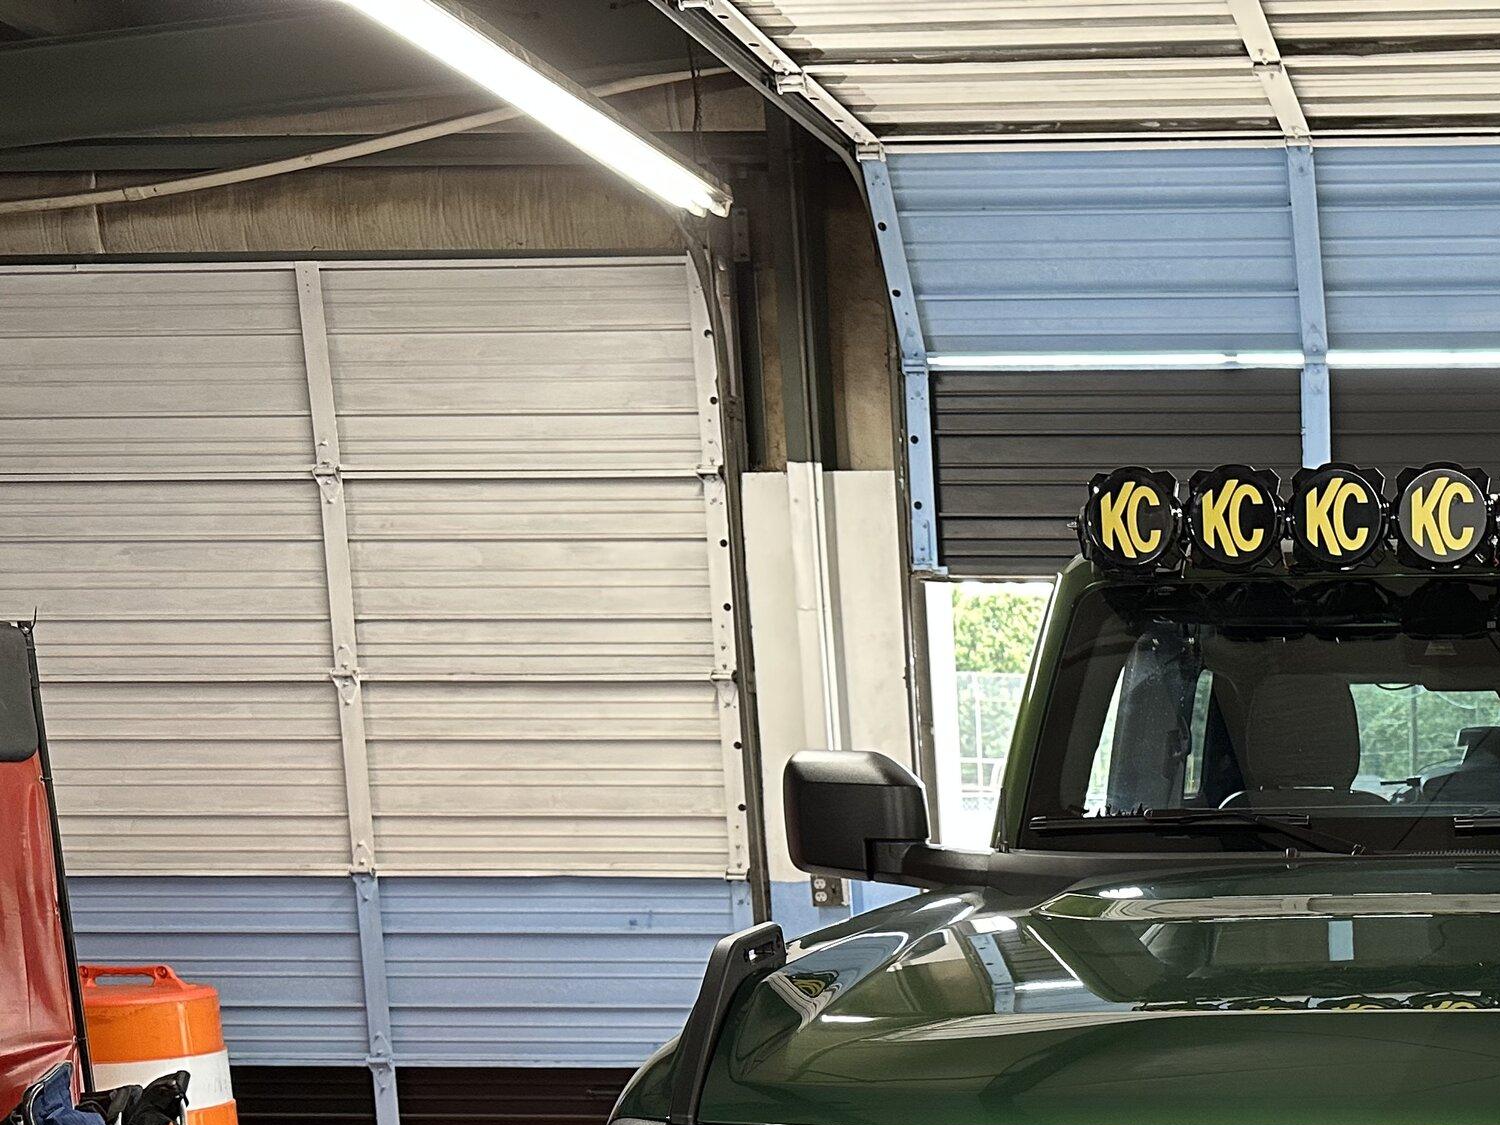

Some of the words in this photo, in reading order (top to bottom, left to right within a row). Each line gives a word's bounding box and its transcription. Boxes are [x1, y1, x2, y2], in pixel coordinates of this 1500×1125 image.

[1101, 482, 1162, 558] KC
[1202, 479, 1263, 557] KC
[1306, 478, 1368, 556] KC
[1411, 477, 1474, 555] KC
